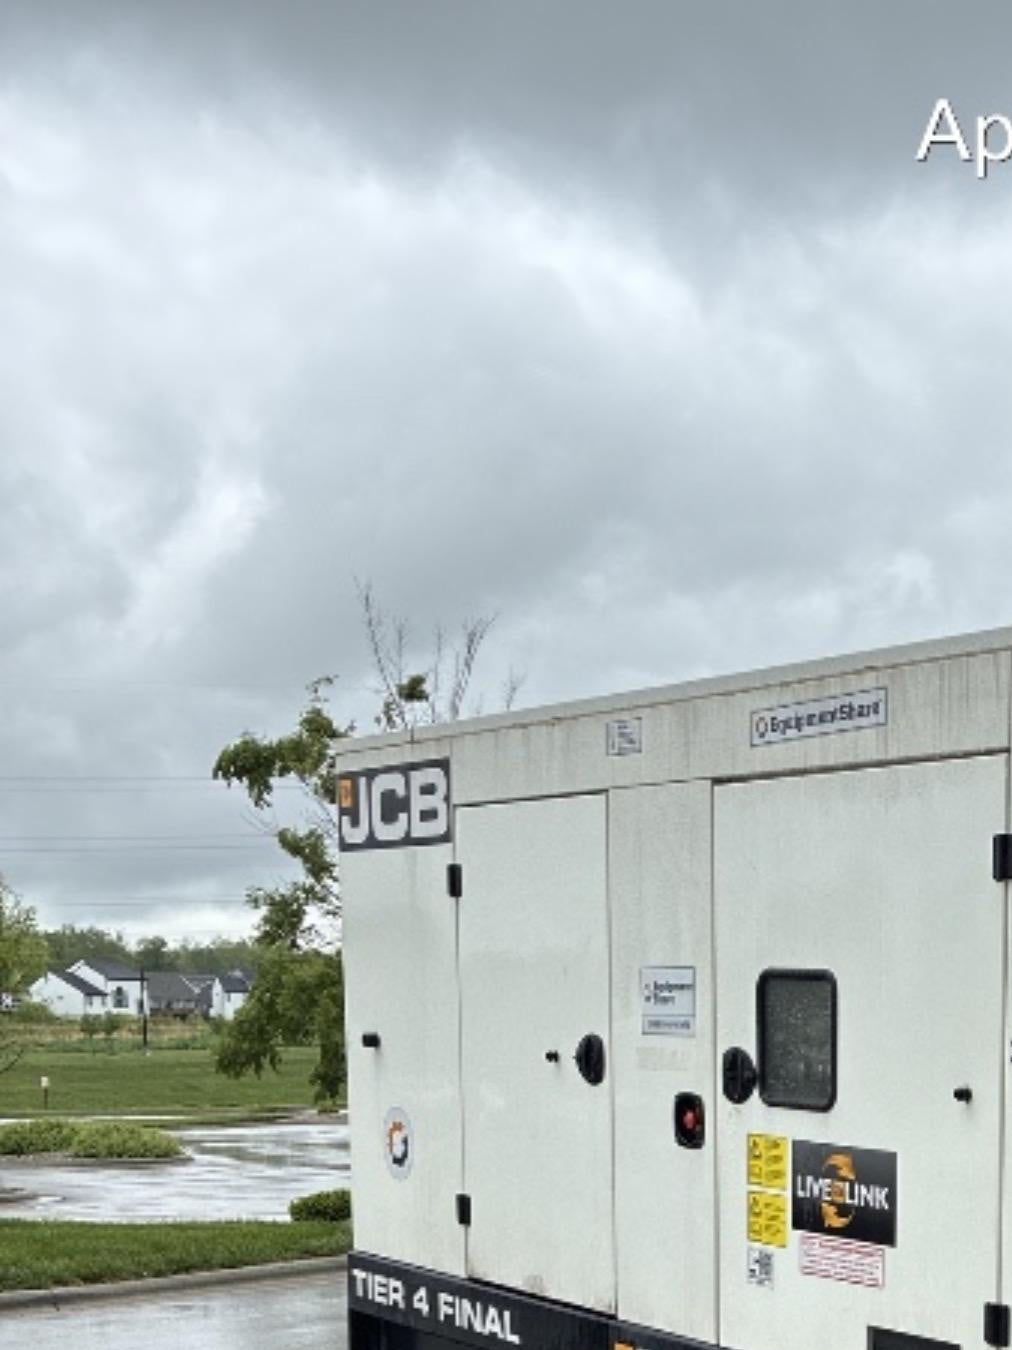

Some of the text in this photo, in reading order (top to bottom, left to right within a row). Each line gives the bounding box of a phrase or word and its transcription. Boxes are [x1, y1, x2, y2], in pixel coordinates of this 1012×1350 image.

[341, 767, 448, 844] JCB
[352, 1268, 521, 1345] TIER 4 FINAL
